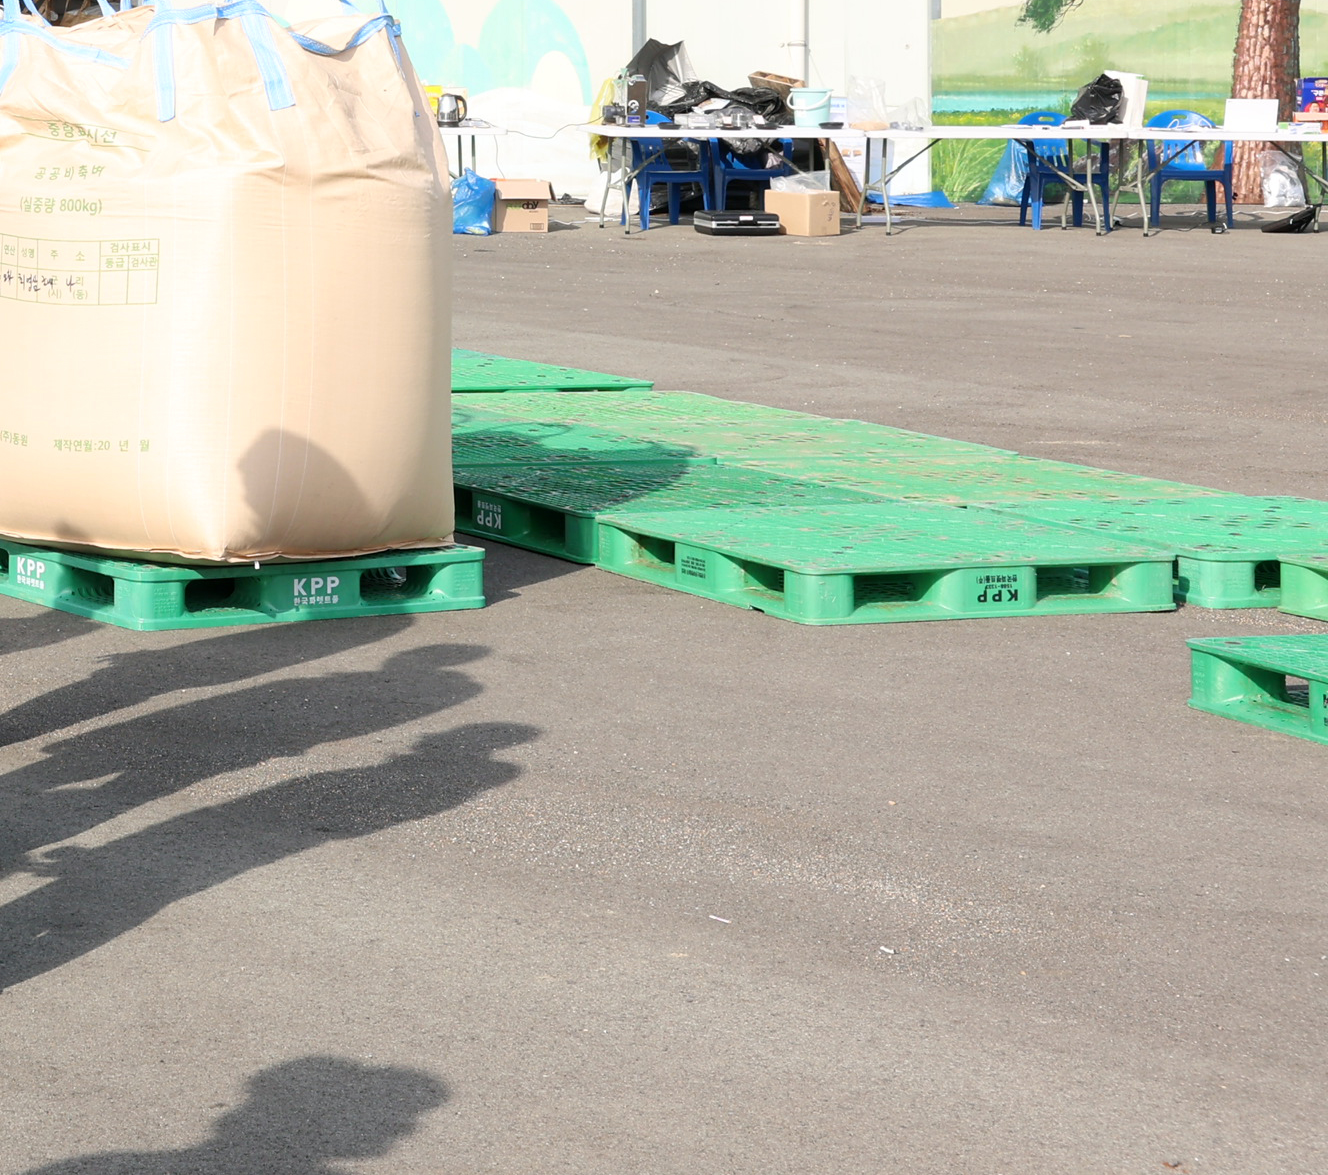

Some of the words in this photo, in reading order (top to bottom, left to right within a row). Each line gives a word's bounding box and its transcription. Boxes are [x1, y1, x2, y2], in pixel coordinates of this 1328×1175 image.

[34, 165, 105, 181] 공공비축벼
[20, 196, 56, 213] (실중량
[59, 198, 103, 215] 800kg)
[110, 241, 151, 252] 검사표시
[21, 248, 35, 259] 성명
[50, 250, 59, 260] 주
[75, 251, 85, 262] 소
[105, 258, 125, 268] 등급
[131, 257, 157, 268] 검사관
[119, 440, 129, 452] 년
[140, 439, 150, 452] 월
[477, 510, 502, 530] KPP
[16, 556, 46, 579] KPP
[293, 576, 340, 596] KPP
[977, 589, 1019, 602] KPP
